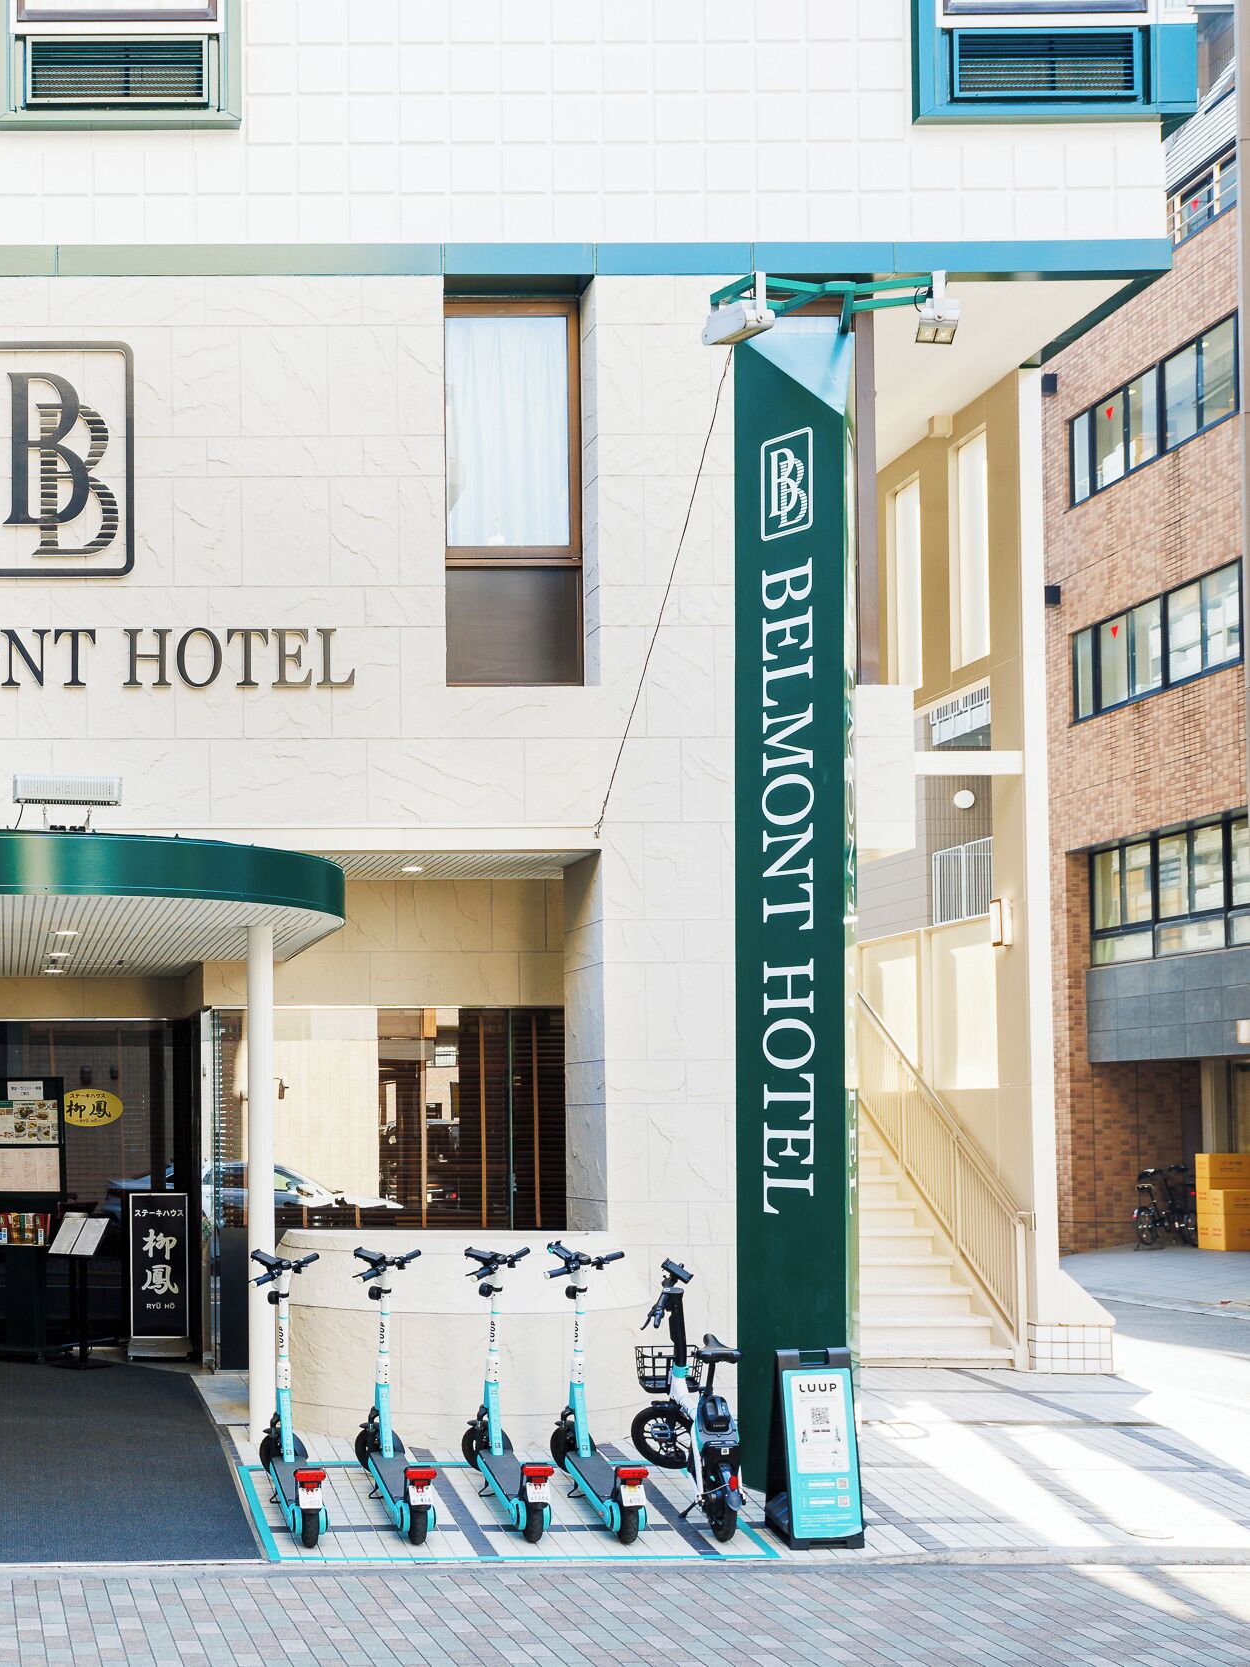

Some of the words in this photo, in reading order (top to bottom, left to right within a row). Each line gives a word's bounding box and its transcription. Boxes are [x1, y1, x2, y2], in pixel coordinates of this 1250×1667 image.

[123, 627, 357, 688] HOTEL
[761, 556, 815, 931] BELMONT
[762, 958, 816, 1215] HOTEL
[134, 1209, 184, 1217] ステーキハウス
[798, 1383, 837, 1393] LUUP
